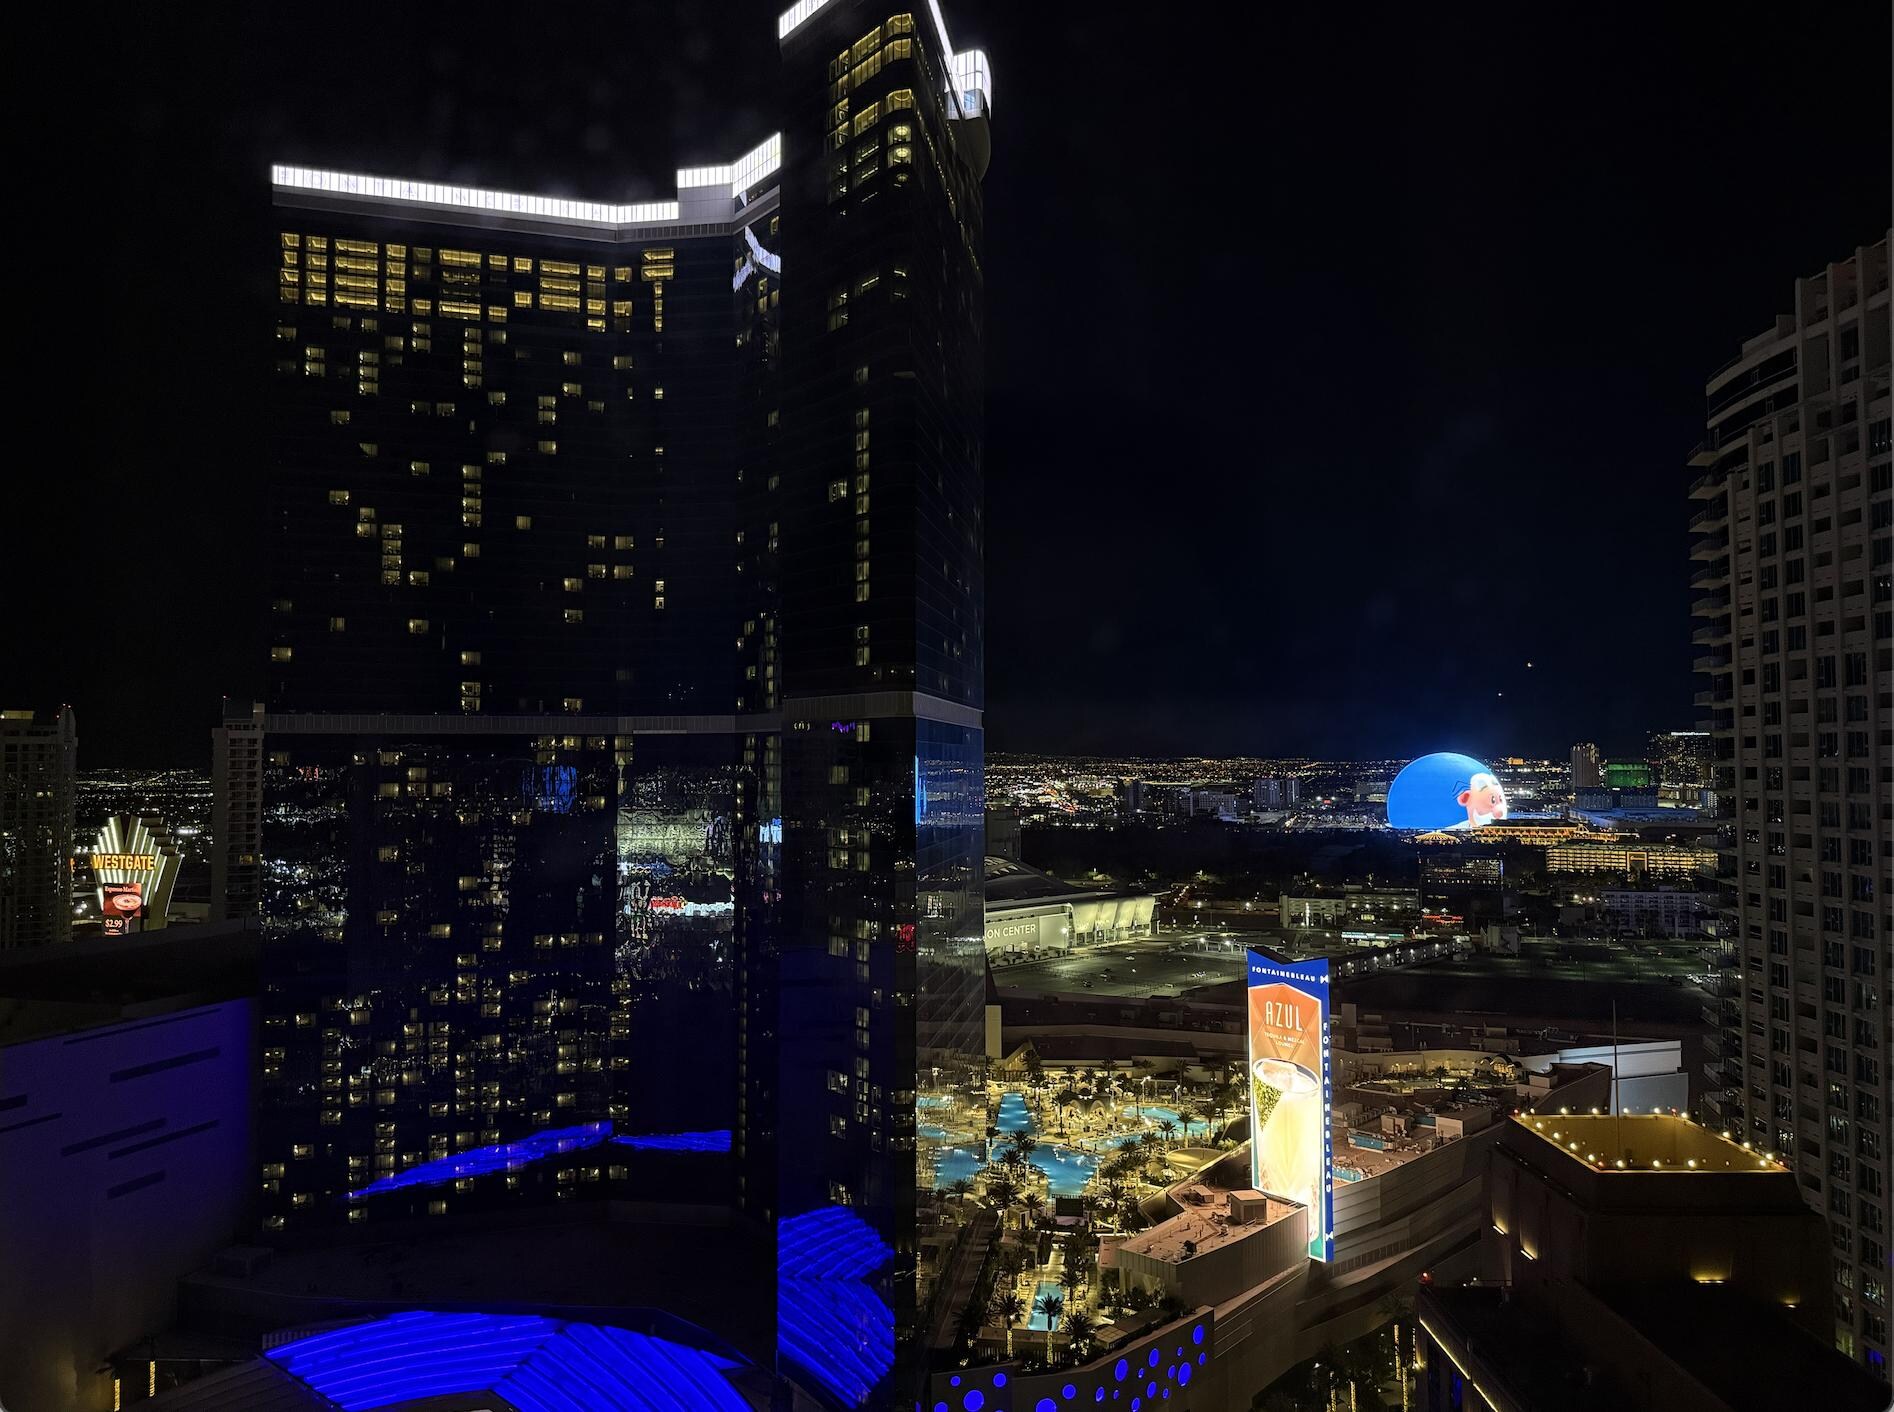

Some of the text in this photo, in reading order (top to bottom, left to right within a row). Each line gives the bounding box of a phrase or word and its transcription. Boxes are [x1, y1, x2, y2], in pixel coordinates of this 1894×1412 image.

[93, 855, 154, 870] WESTGATE
[105, 919, 123, 928] $2.99
[1003, 924, 1036, 937] CENTER
[1252, 966, 1316, 982] FONTAINEBLEAU
[1265, 1001, 1303, 1032] AZUL
[1322, 1022, 1332, 1193] FONTAINEBLEAU
